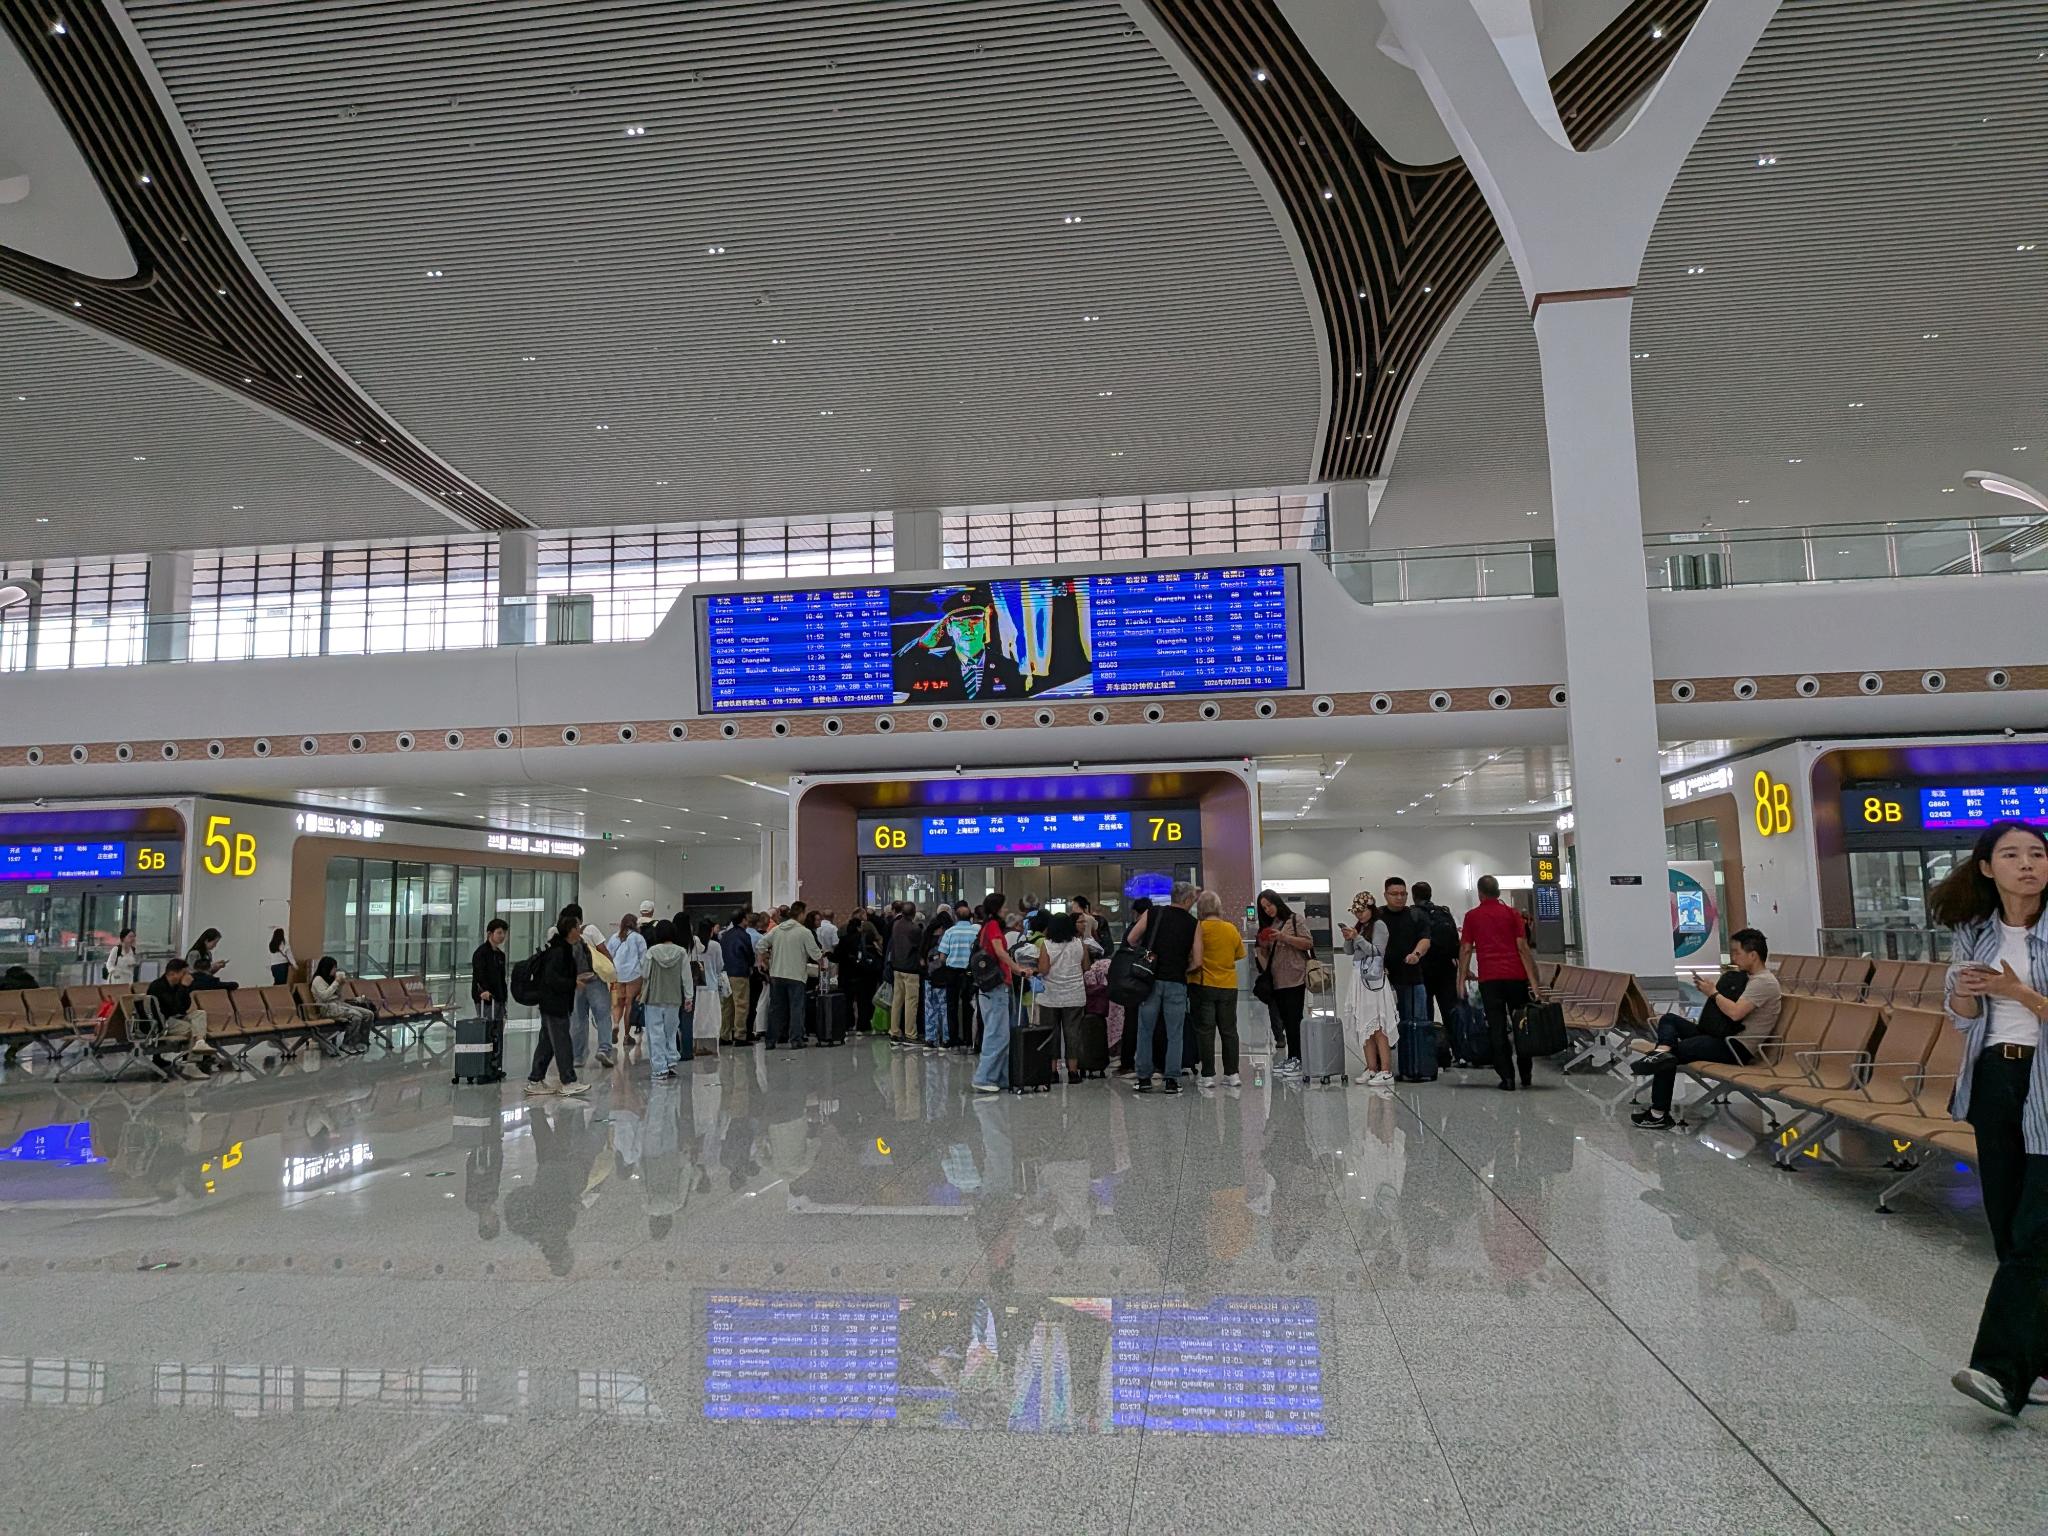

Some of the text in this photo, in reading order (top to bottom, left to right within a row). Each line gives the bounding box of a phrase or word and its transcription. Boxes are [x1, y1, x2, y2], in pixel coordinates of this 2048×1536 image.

[1106, 681, 1176, 691] 开车前3分钟停止检票
[1754, 770, 1793, 837] 8B
[1864, 797, 1902, 822] 8B
[336, 818, 361, 835] 1B-3B
[875, 826, 907, 848] 6B
[1149, 818, 1181, 841] 7B
[205, 816, 257, 876] 5B
[137, 849, 165, 870] 5B
[1539, 861, 1552, 870] 8B
[1540, 870, 1553, 880] 9B
